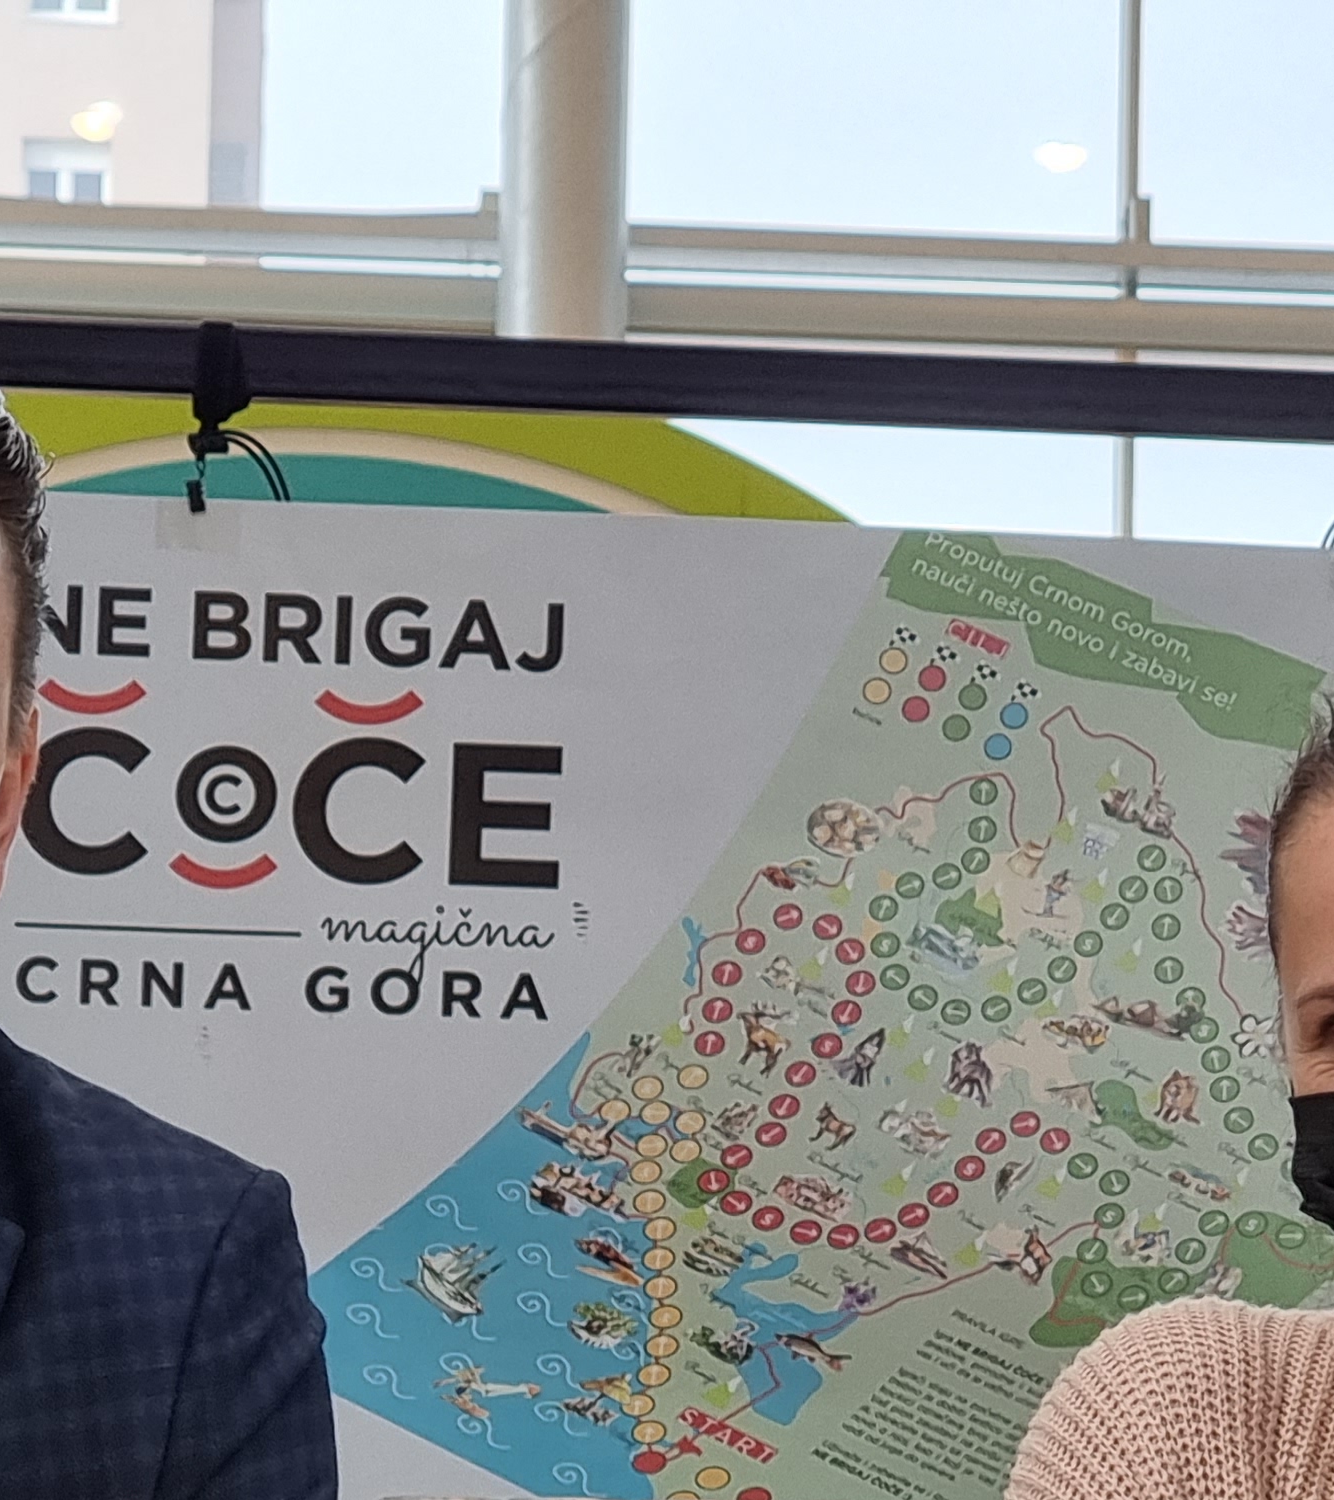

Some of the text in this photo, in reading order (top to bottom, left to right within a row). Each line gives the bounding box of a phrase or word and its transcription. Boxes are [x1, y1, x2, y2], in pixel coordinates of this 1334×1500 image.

[41, 584, 565, 673] NE BRIGAJ
[924, 532, 1193, 663] Proputuj Crnom Gorom,
[1046, 618, 1104, 654] novo
[1121, 645, 1196, 694] zabavi
[1202, 681, 1239, 712] se!
[320, 903, 556, 985] magična
[14, 954, 549, 1021] CRNA GORA
[684, 1408, 775, 1464] START
